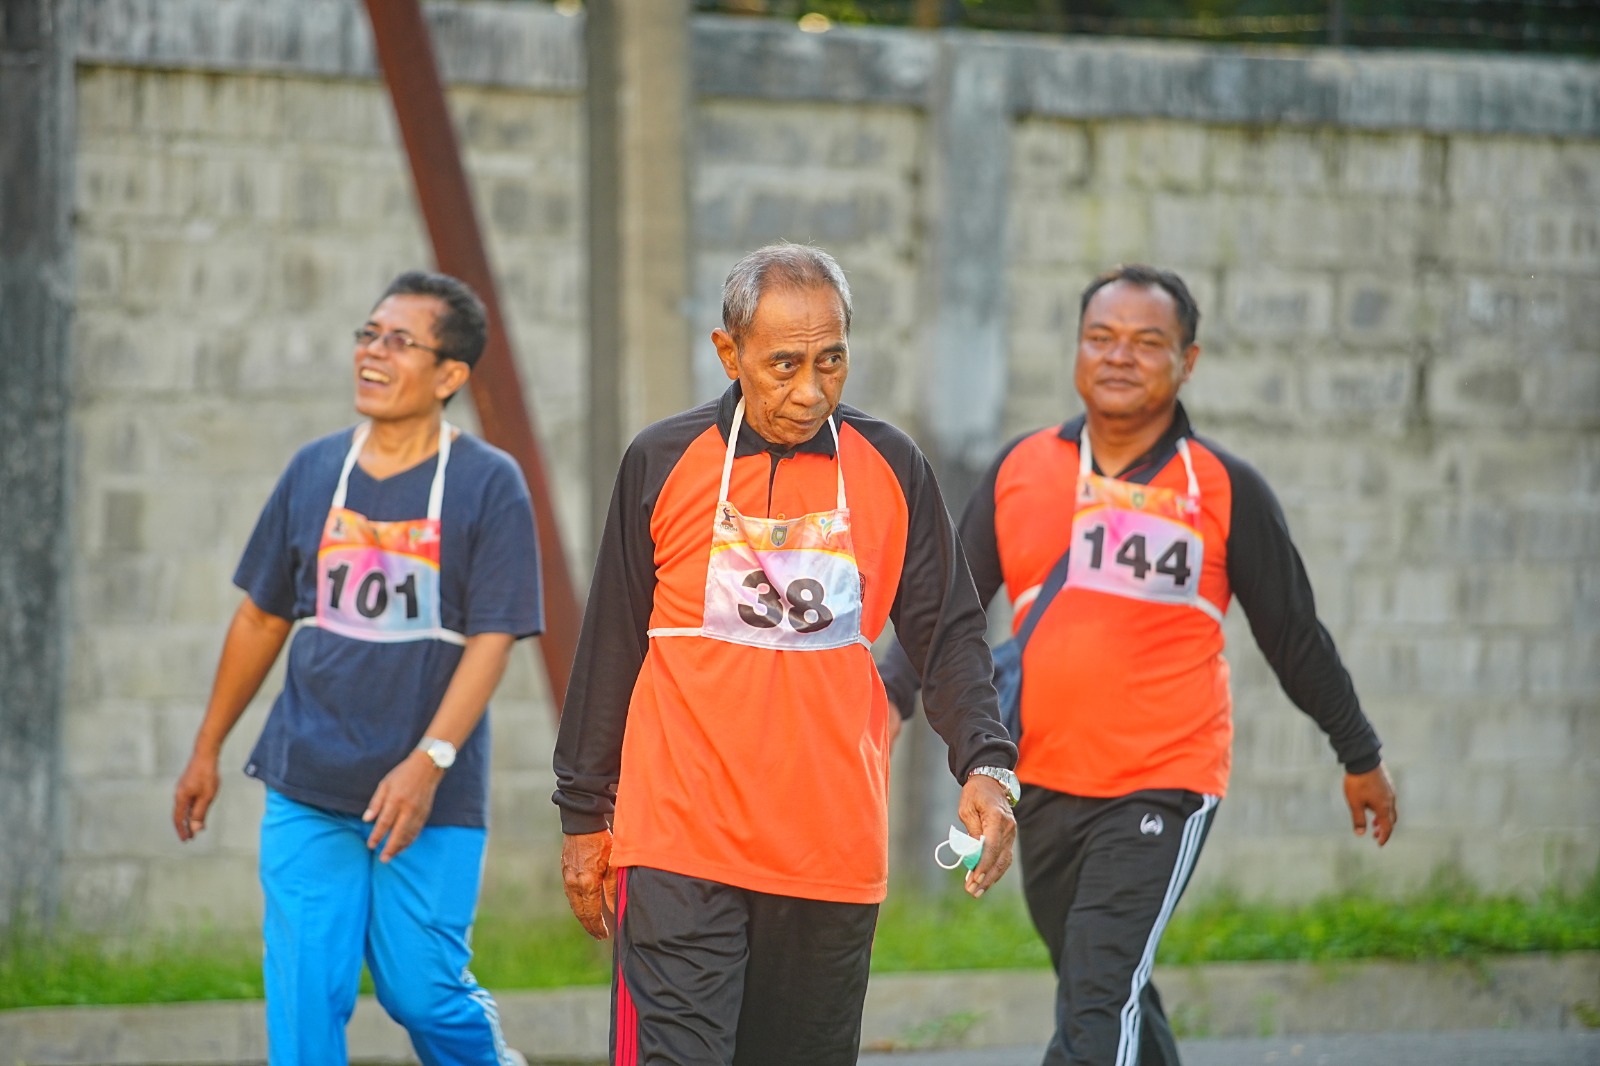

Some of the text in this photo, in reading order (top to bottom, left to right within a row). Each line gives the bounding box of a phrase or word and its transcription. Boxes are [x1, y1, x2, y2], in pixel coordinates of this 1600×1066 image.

[1083, 525, 1191, 587] 144
[327, 563, 419, 619] 101
[737, 569, 834, 634] 38
